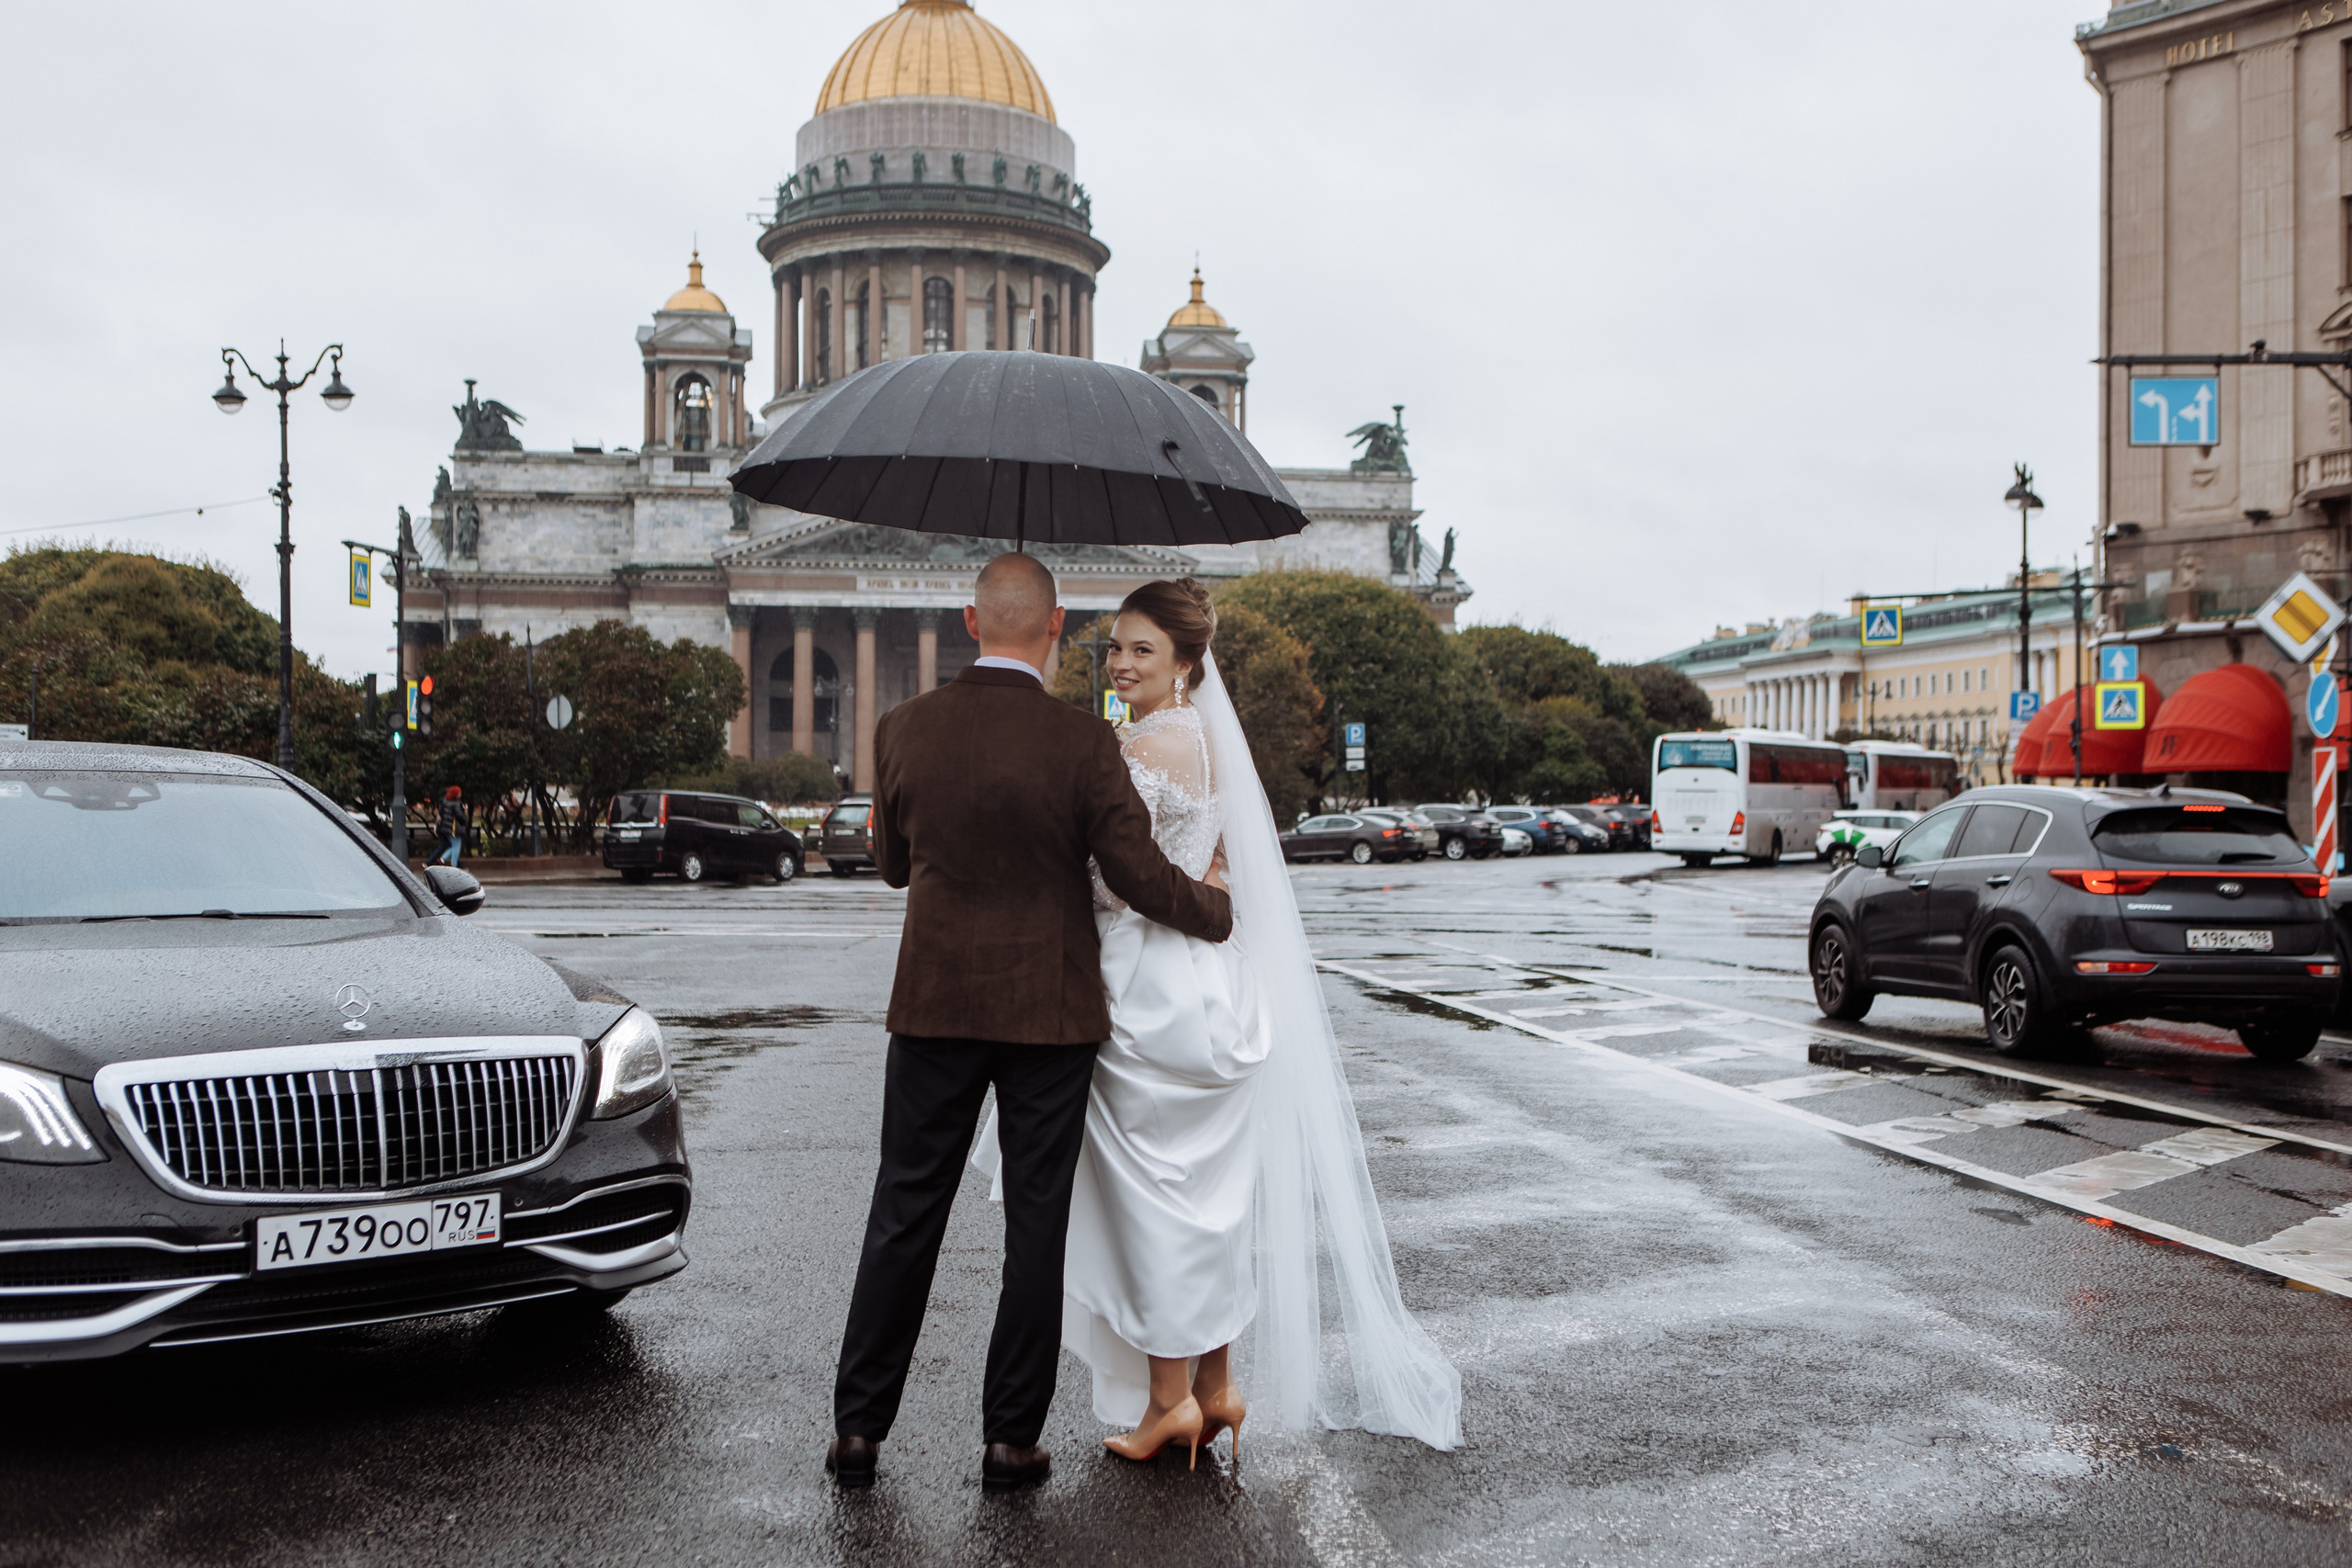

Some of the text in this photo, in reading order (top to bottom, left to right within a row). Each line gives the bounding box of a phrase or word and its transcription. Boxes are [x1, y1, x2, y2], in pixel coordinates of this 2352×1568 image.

[2165, 31, 2233, 67] HOTEL
[435, 1199, 490, 1233] 797
[448, 1229, 475, 1243] RUS
